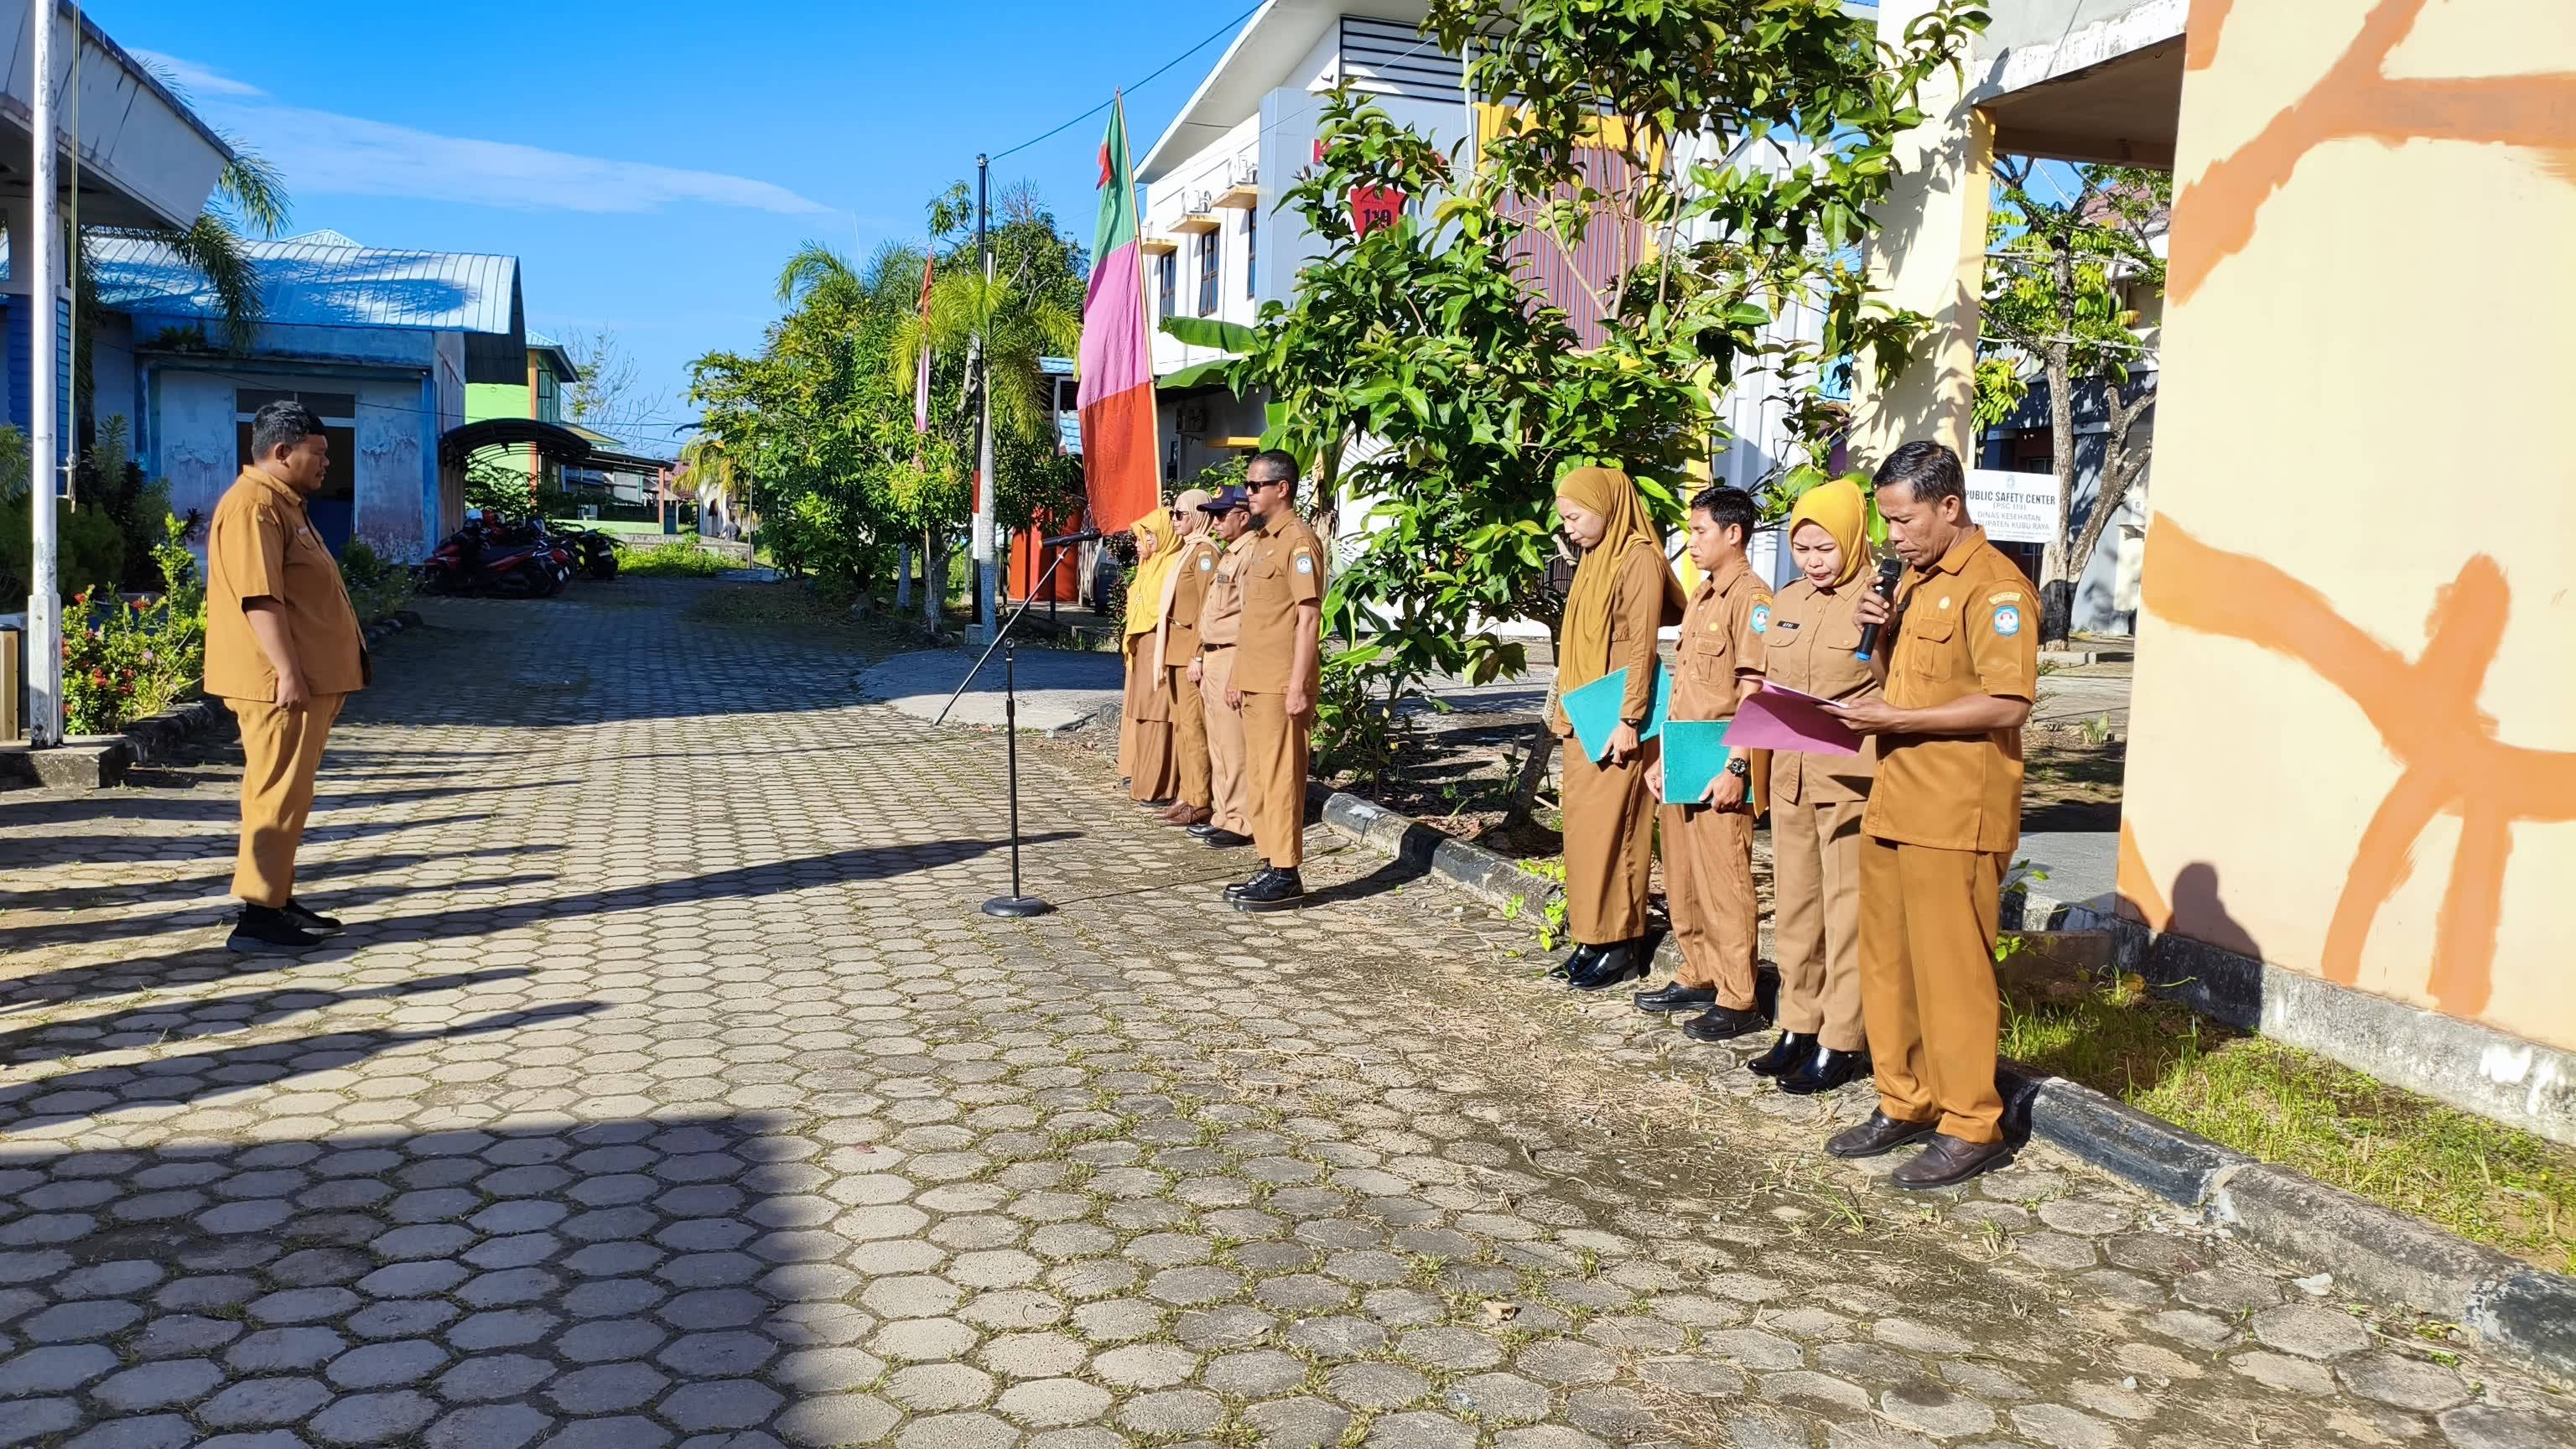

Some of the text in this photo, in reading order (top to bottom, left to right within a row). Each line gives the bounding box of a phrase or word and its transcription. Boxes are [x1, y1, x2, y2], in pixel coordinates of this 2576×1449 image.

[1966, 490, 2055, 505] PUBLIC SAFETY CENTER
[2002, 513, 2041, 522] KESEHATAN
[2012, 522, 2031, 530] KUBU
